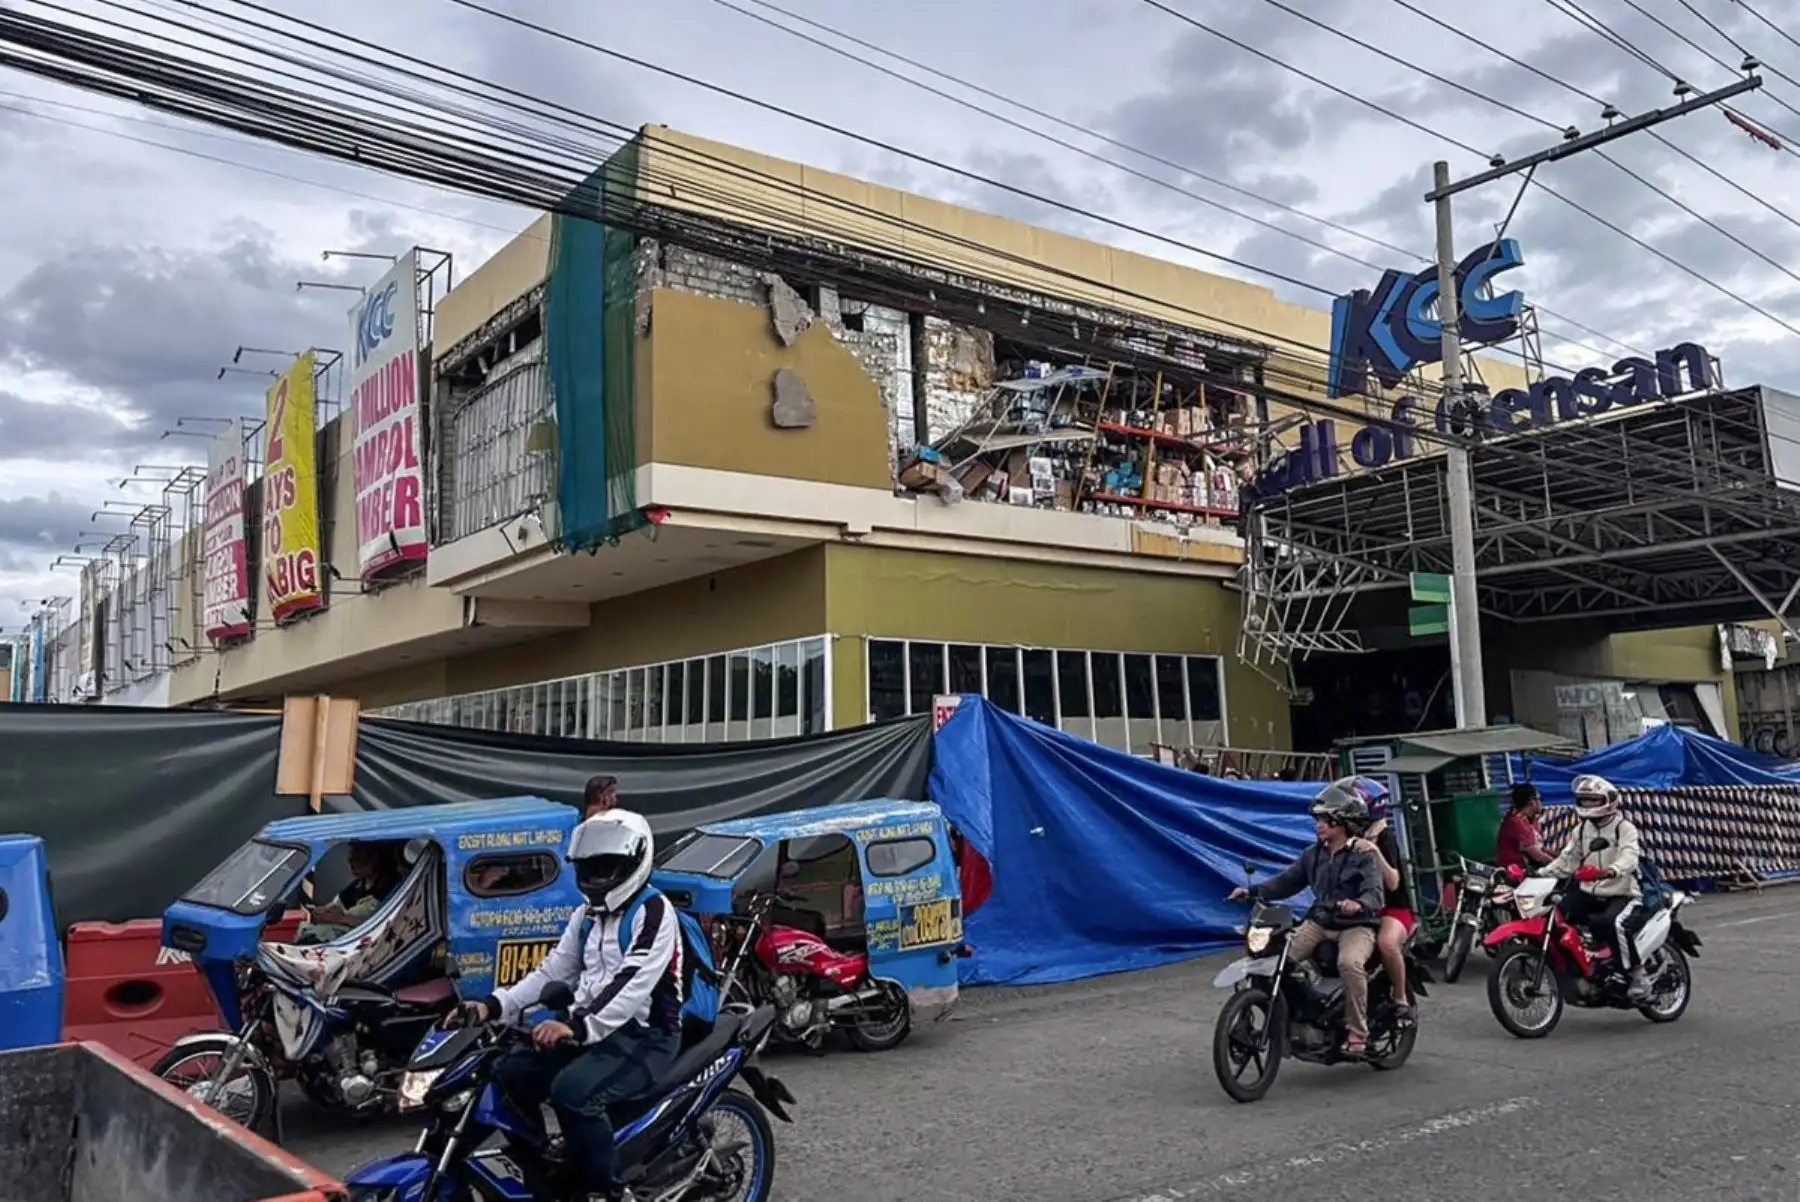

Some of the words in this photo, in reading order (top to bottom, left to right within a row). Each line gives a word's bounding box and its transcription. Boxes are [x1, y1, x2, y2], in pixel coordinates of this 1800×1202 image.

[356, 280, 398, 369] KCC
[1328, 238, 1524, 399] KCC
[360, 348, 415, 428] MILLION
[1351, 395, 1417, 467] of
